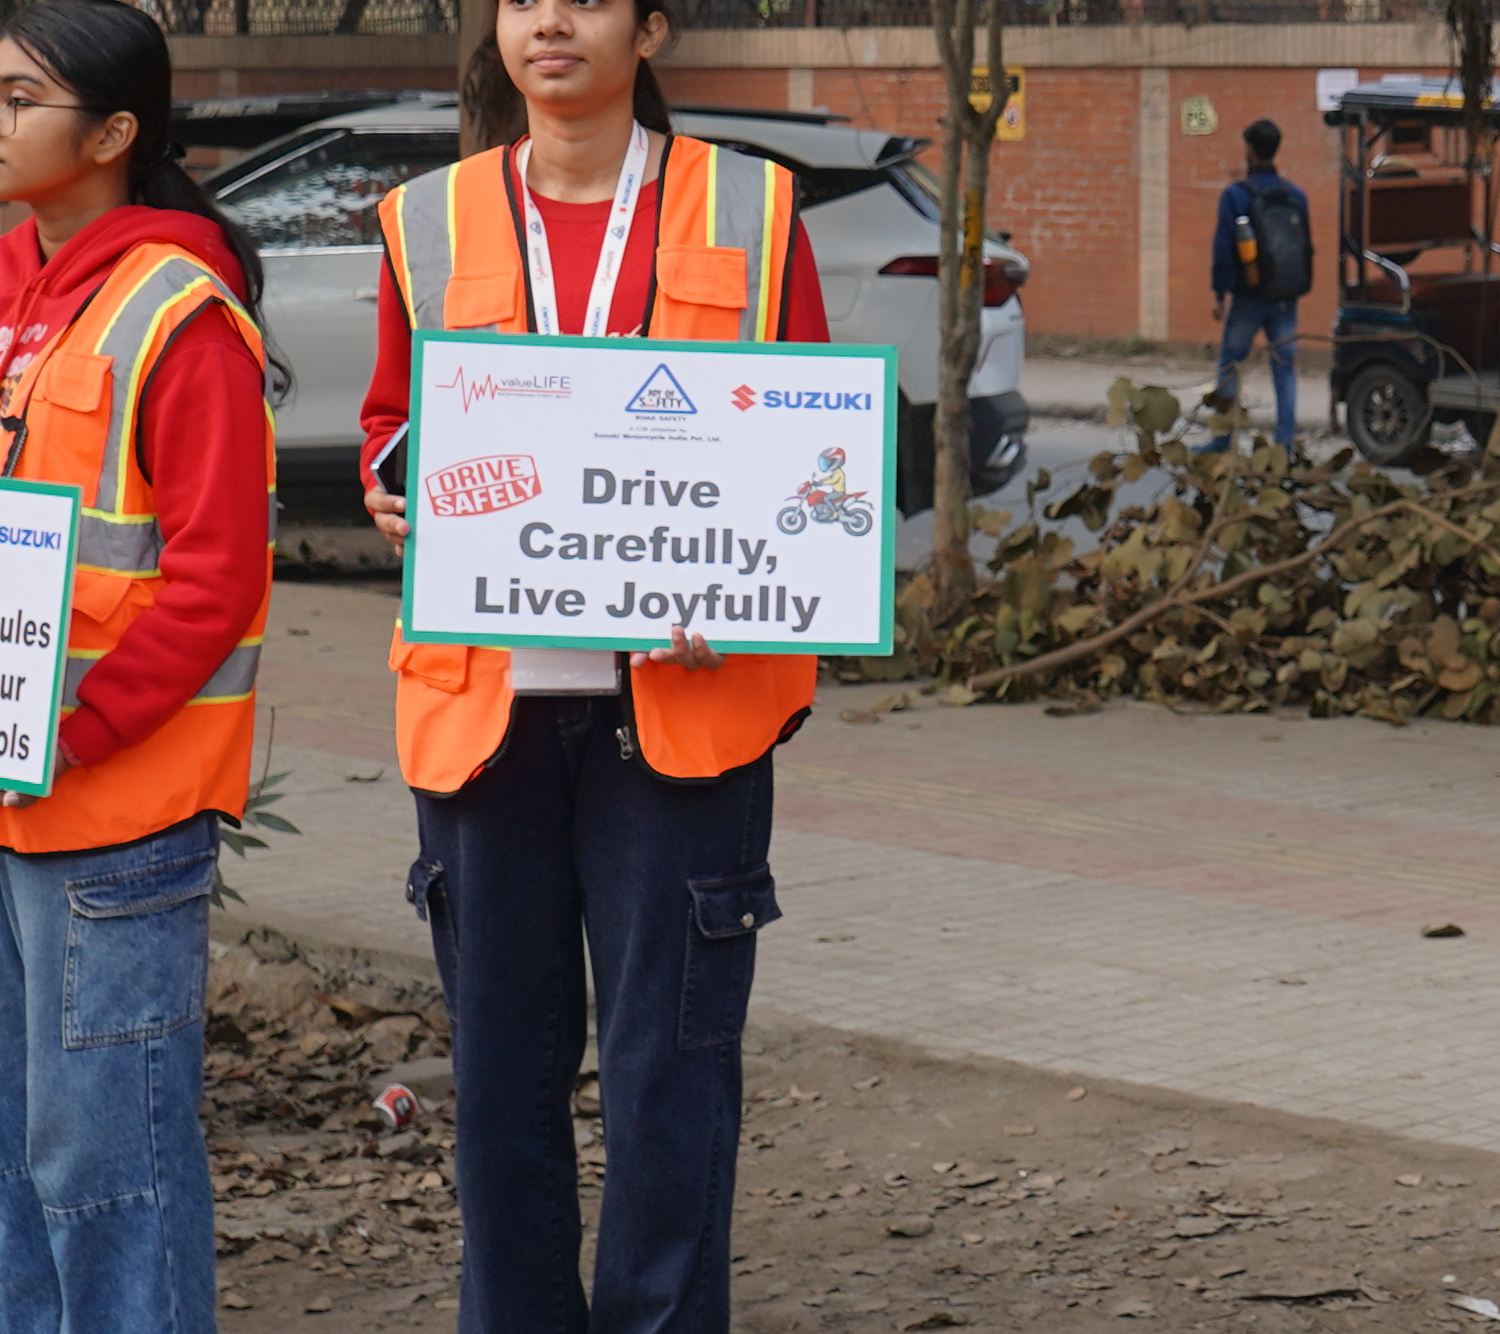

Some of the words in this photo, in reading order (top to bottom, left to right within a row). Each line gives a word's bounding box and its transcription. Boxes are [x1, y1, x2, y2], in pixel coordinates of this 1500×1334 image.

[501, 375, 571, 390] valueLIFE
[763, 390, 872, 411] SUZUKI
[438, 458, 524, 493] DRIVE
[583, 467, 720, 507] Drive
[434, 477, 535, 515] SAFELY
[519, 522, 778, 575] Carefully,
[475, 577, 586, 616] Live
[605, 581, 821, 632] Joyfully
